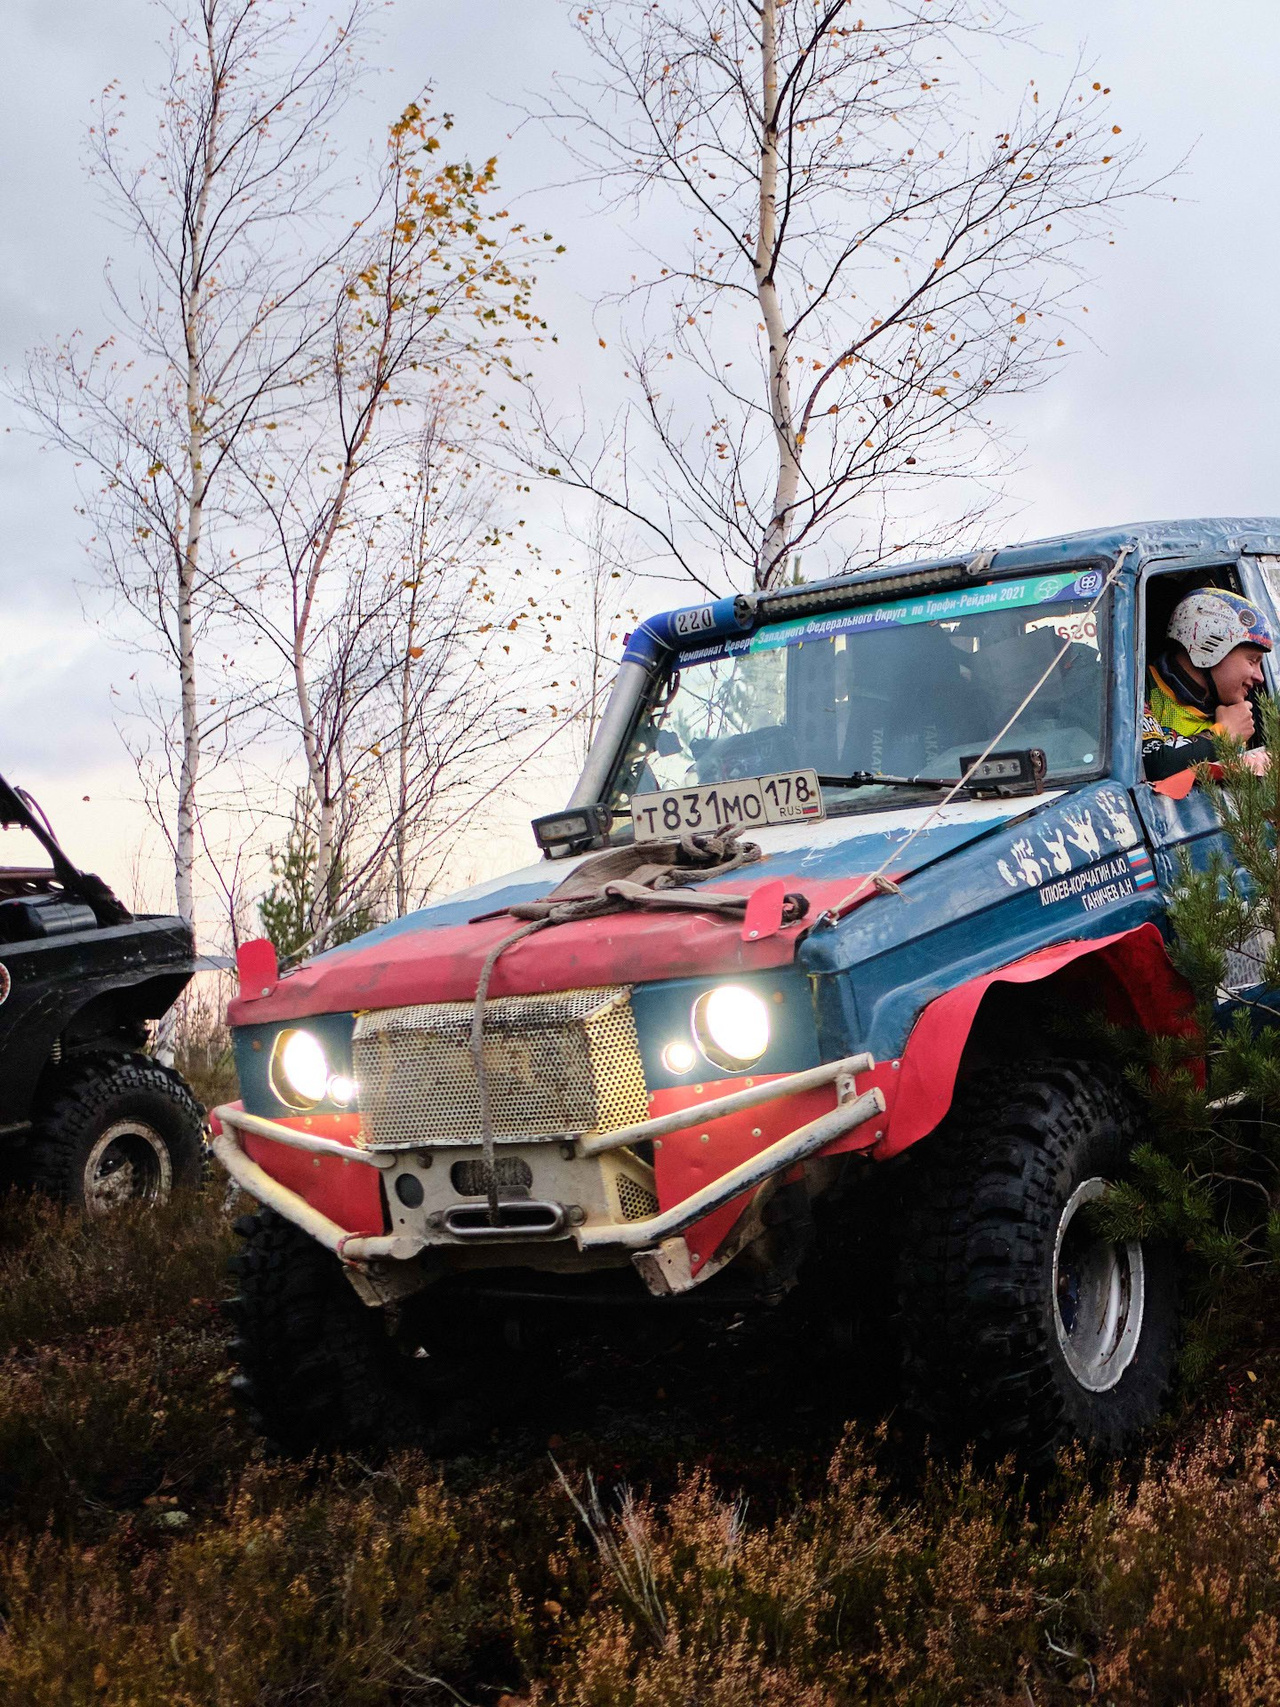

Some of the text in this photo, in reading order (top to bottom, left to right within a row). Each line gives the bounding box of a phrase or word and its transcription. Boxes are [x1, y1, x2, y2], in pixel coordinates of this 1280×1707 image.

[677, 608, 712, 633] 220
[679, 586, 1026, 663] Чемпионат Северо-Западного Федерального Округа по Трофи-Рейдам 2021
[643, 776, 810, 834] Т831МО 178
[780, 804, 802, 818] RUS
[1039, 857, 1130, 907] КЛЮЕВ-КОРЧАГИН А.Ю.
[1081, 883, 1120, 911] ГАНИЧЕВ
